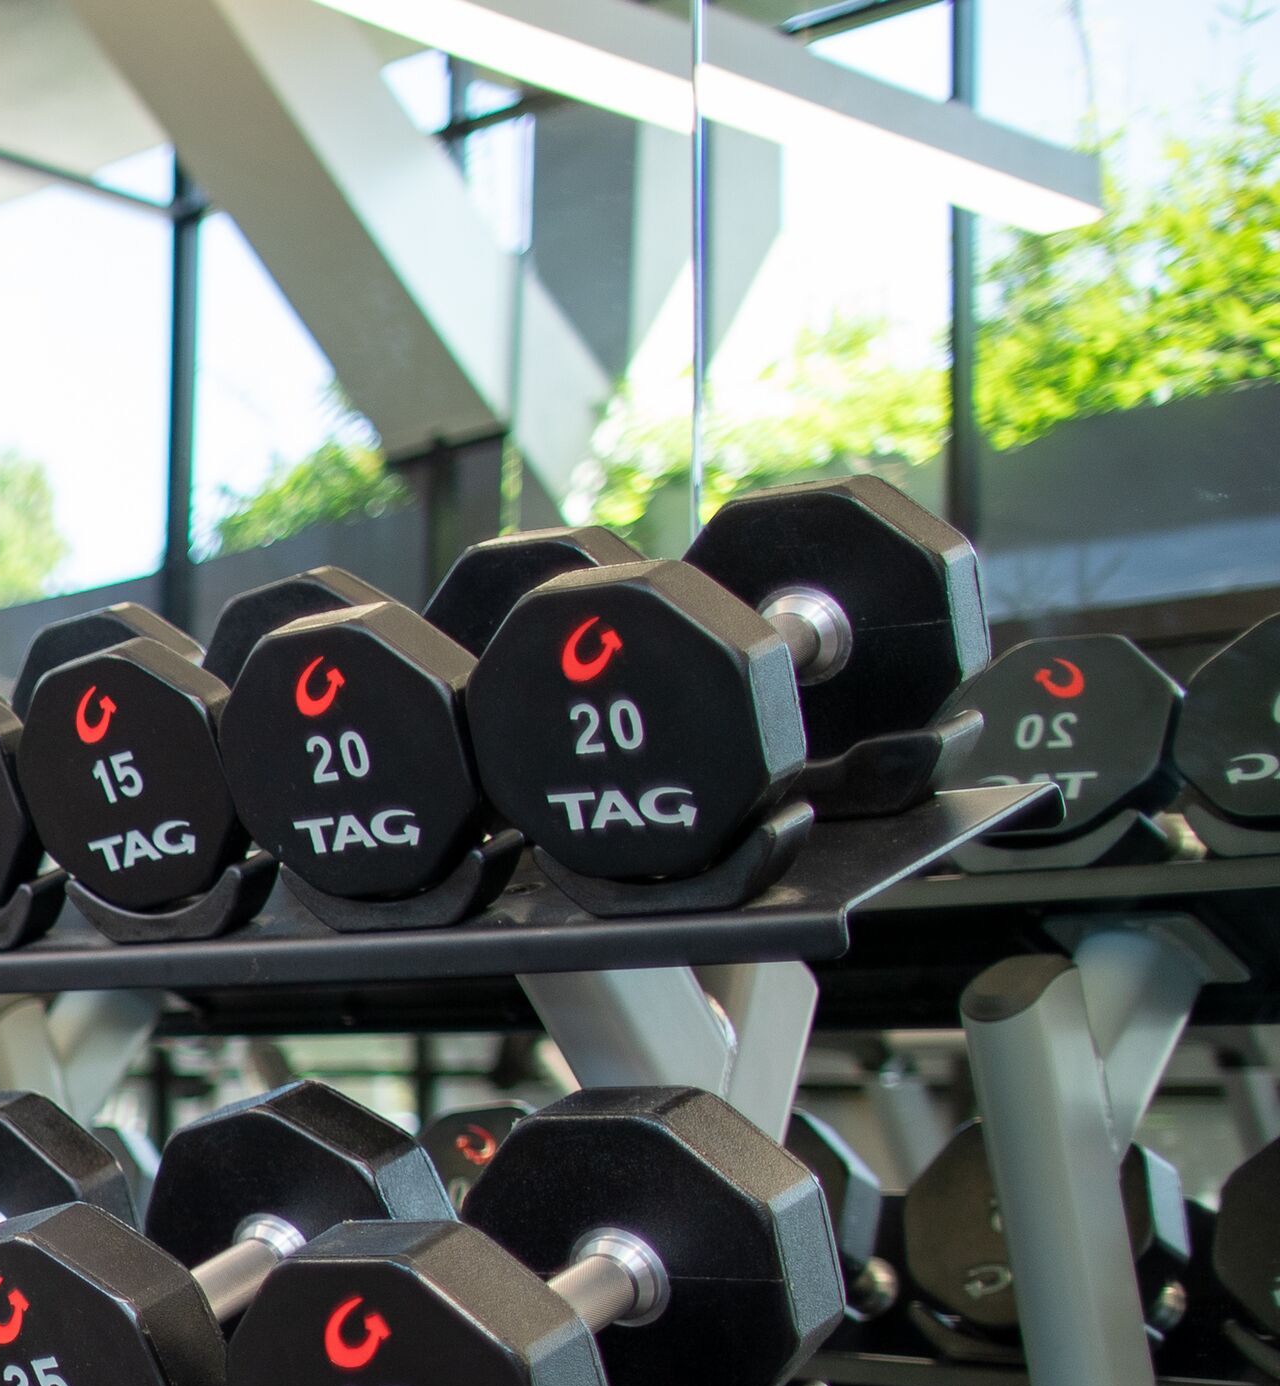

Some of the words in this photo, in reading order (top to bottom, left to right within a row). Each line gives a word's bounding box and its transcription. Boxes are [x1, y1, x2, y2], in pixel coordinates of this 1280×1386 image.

[570, 700, 643, 754] 20
[93, 751, 143, 803] 15
[306, 731, 369, 783] 20
[293, 810, 420, 854] TAG
[547, 787, 697, 830] TAG
[88, 821, 195, 871] TAG
